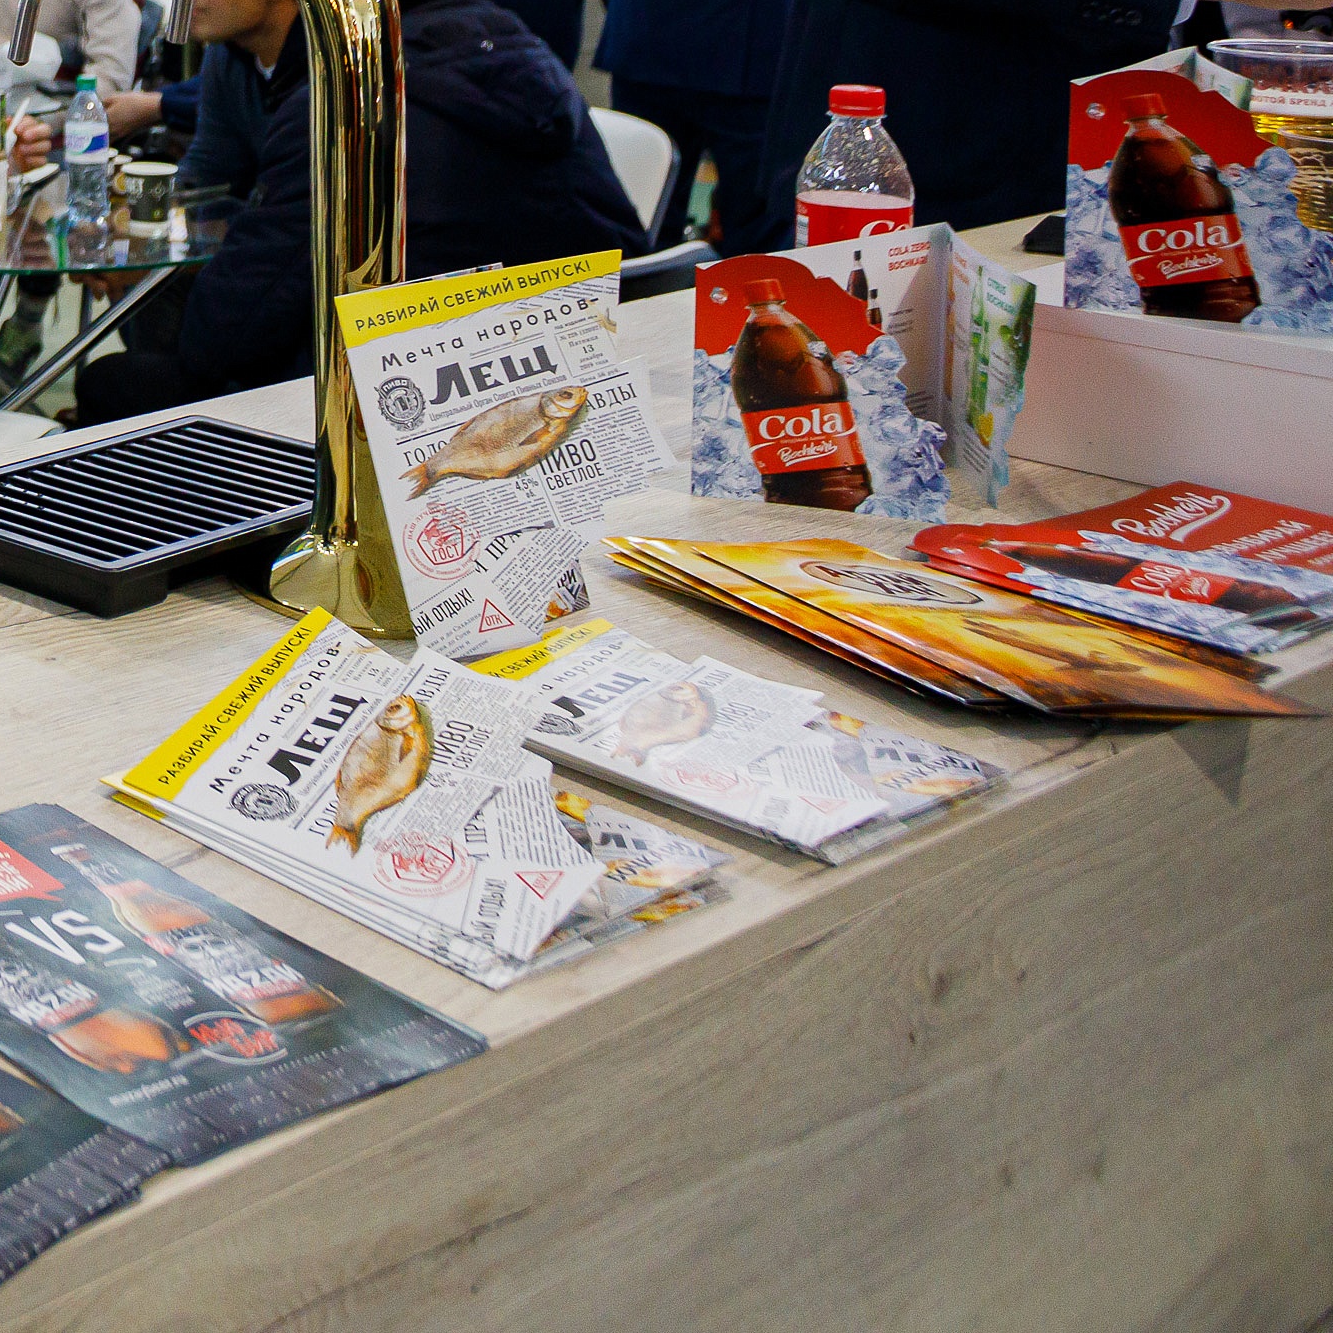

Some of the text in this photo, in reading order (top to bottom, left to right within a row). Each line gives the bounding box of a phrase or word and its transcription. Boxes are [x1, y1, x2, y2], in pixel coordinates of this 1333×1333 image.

[888, 241, 931, 257] COLA ZERO
[1137, 221, 1229, 253] Cola
[355, 260, 592, 332] РАЗБИРАЙ СВЕЖИЙ ВЫПУСК!
[380, 337, 464, 371] Мечта
[582, 344, 595, 354] 13
[383, 379, 408, 393] ПИВО
[429, 345, 559, 405] ЛЕЩ
[429, 374, 568, 422] Центральный Орган Совета Пивных Союзов
[758, 408, 844, 440] Cola
[538, 439, 597, 476] ПИВО
[546, 462, 604, 491] СВЕТЛОЕ
[431, 542, 460, 562] ГОСТ
[1130, 563, 1185, 591] Cola
[436, 587, 475, 622] ОТДЫХ!
[484, 613, 503, 627] ОТК
[501, 627, 592, 678] СВЕЖИЙ ВЫПУСК!
[159, 626, 312, 785] РАЗБИРАЙ СВЕЖИЙ ВЫПУСК!
[551, 672, 651, 718] ЛЕЩ
[266, 693, 369, 786] ЛЕЩ
[433, 720, 474, 766] ПИВО
[452, 726, 493, 769] СВЕТЛОЕ
[209, 733, 270, 793] Мечта
[478, 878, 508, 917] ОТДЫХ!
[4, 909, 126, 966] VS
